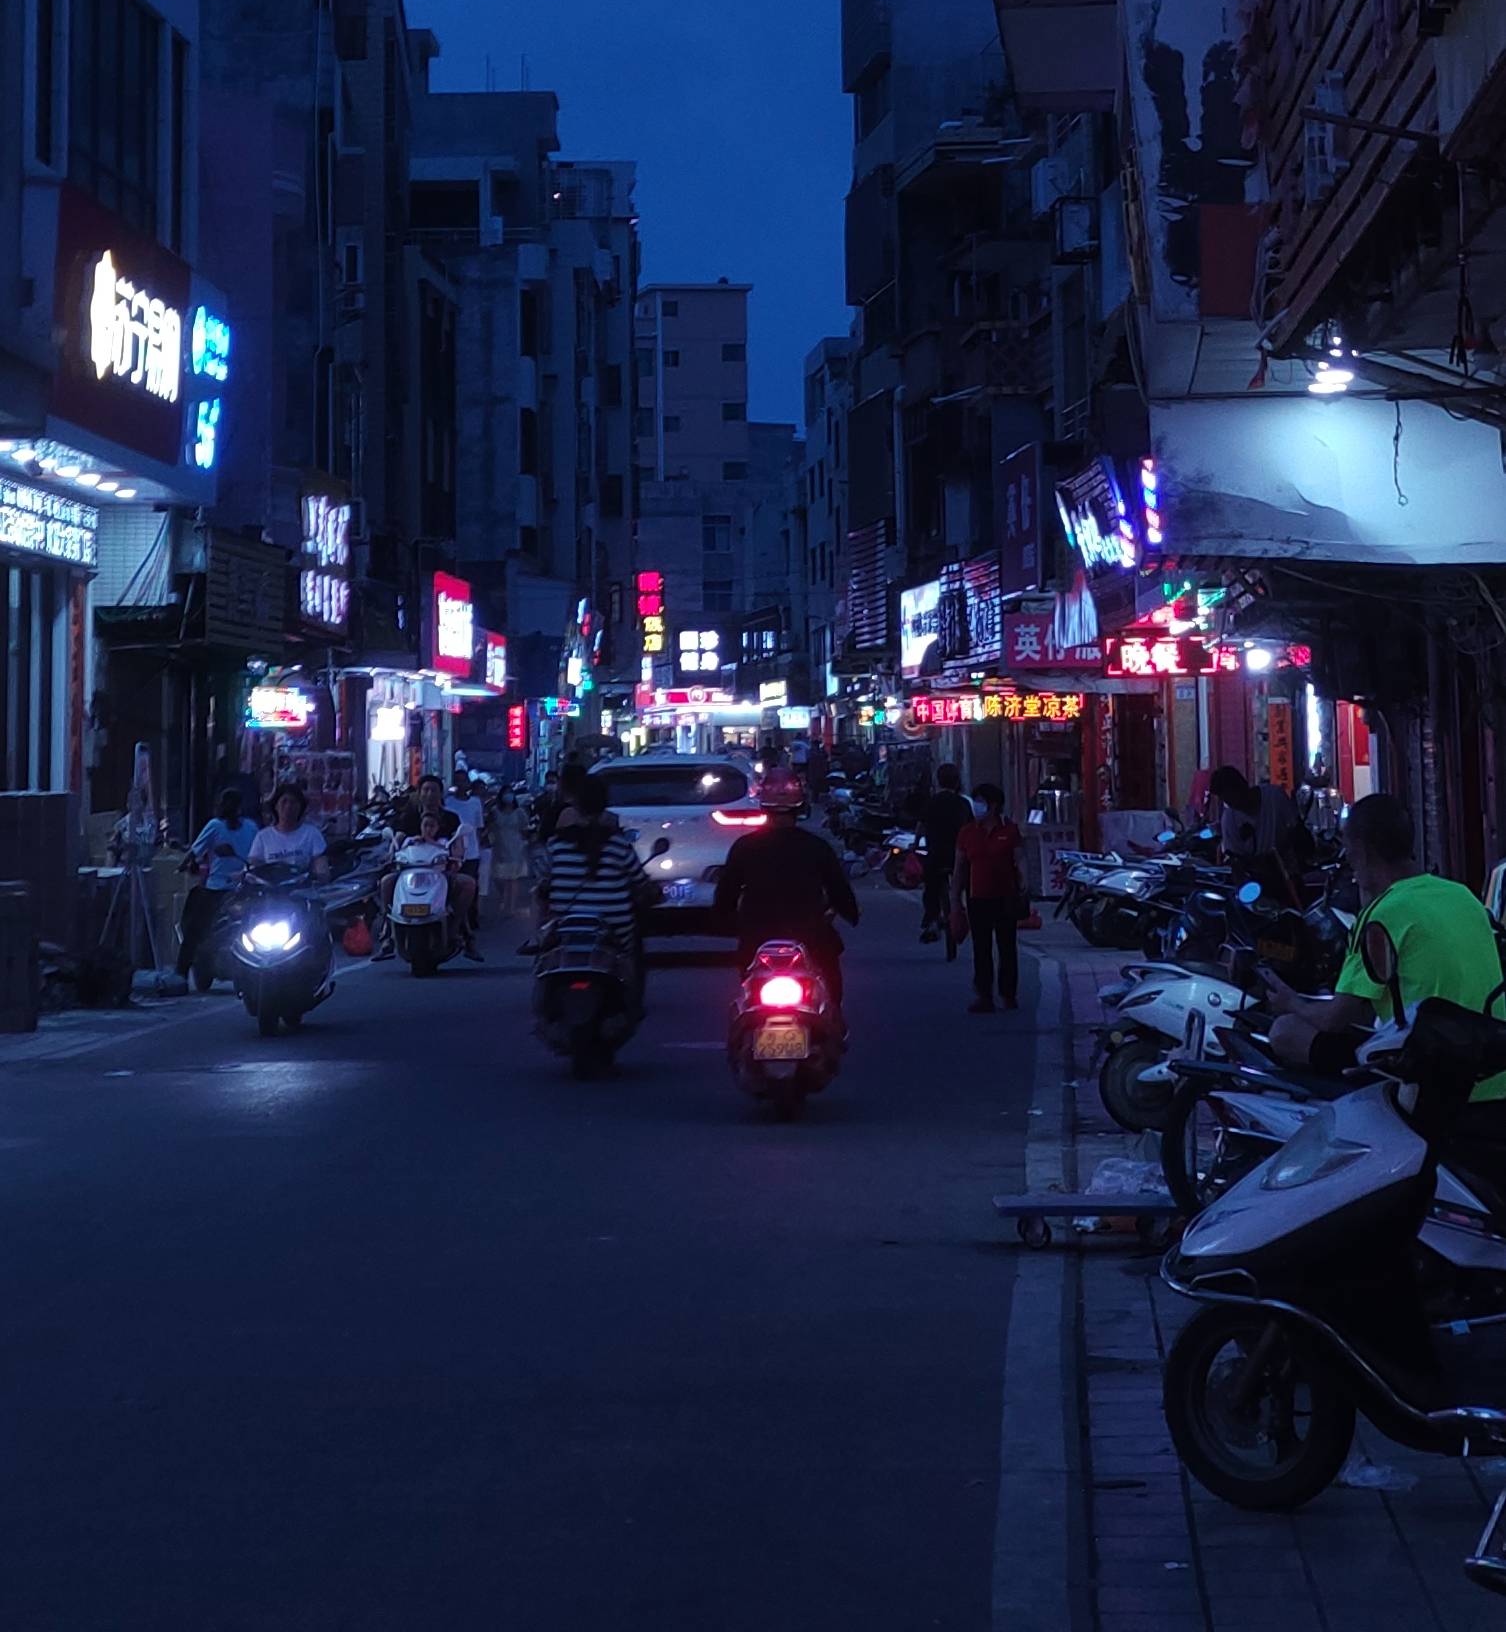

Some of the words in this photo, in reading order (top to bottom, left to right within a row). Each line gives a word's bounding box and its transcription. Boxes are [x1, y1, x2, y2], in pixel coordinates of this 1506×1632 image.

[1119, 642, 1181, 673] 晚餐
[984, 694, 1081, 719] 陈济堂凉茶
